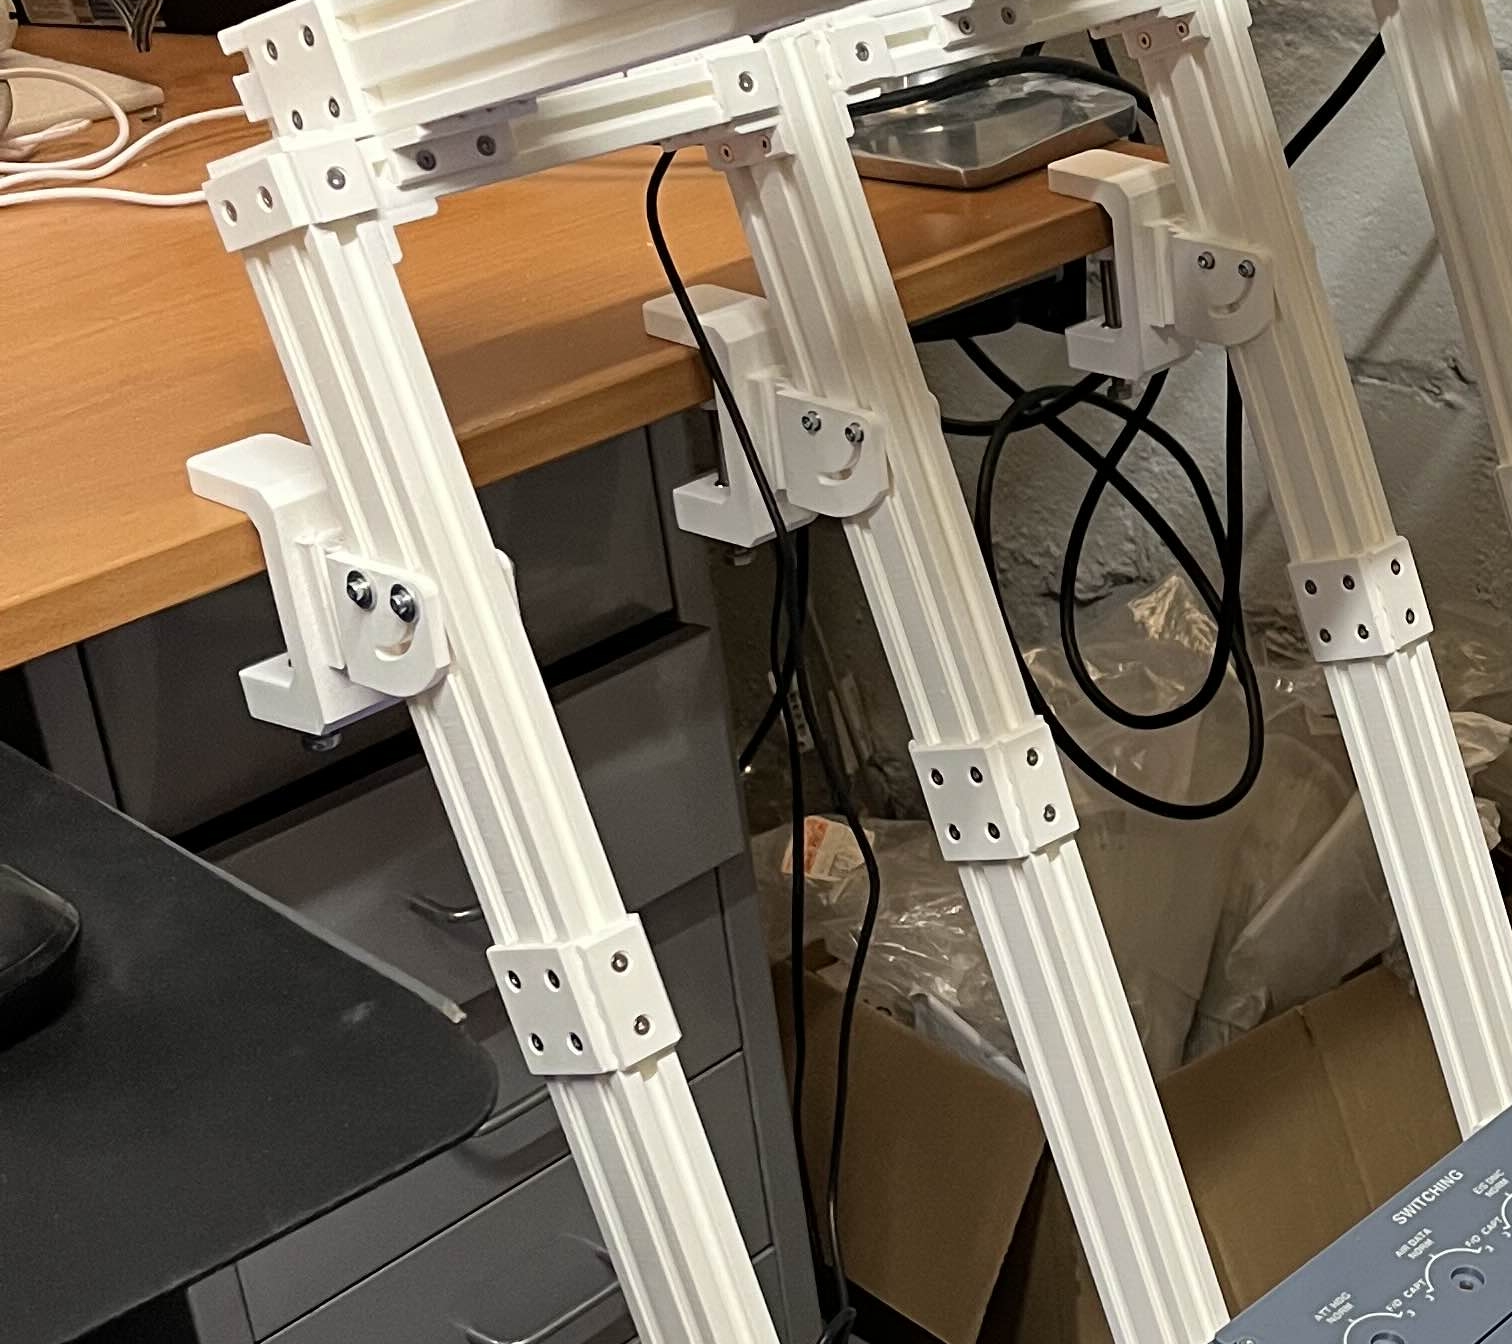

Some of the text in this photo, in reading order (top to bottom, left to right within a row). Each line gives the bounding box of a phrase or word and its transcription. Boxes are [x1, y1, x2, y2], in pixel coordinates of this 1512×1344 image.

[1392, 1169, 1464, 1226] SWITCHING
[1481, 1216, 1503, 1236] CAPT
[1403, 1278, 1425, 1298] CAPT
